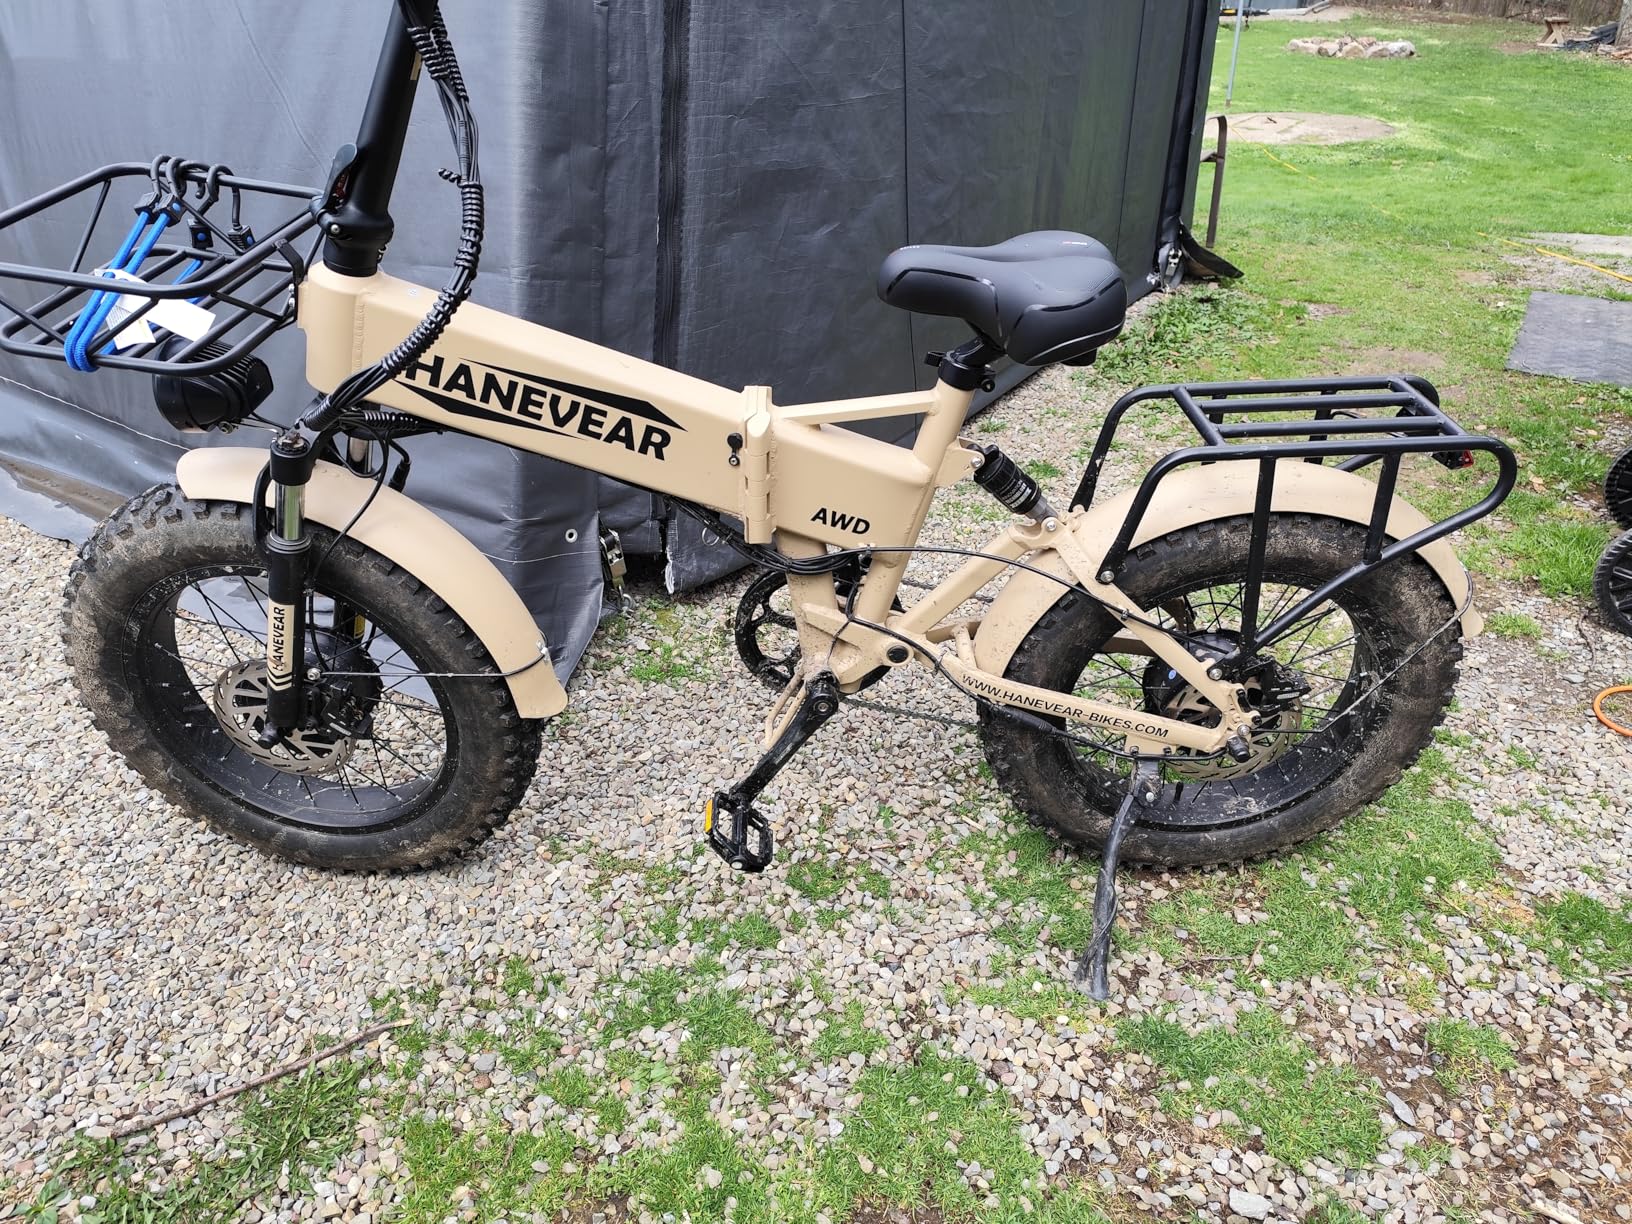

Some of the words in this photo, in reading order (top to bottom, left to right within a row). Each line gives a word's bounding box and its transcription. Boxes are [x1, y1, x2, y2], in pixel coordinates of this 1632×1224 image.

[405, 355, 671, 461] HANEVEAR
[810, 507, 870, 534] AWD
[962, 673, 1169, 738] WWW.HANEVEAR-BIKES.COM
